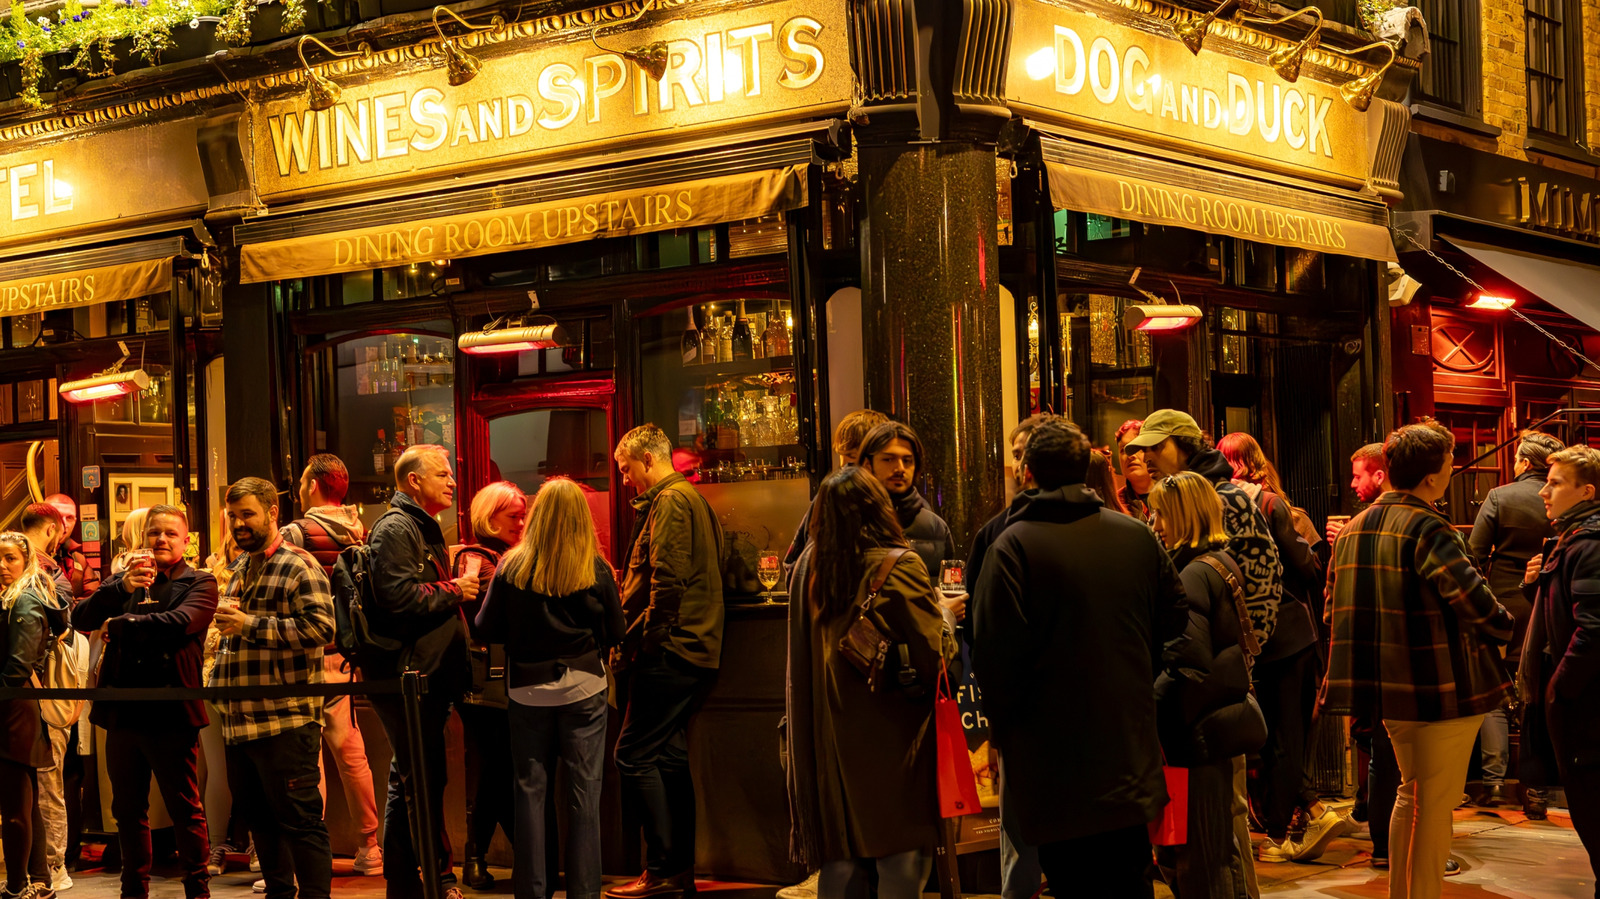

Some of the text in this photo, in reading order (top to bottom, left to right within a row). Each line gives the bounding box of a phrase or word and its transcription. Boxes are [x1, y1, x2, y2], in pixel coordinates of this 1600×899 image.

[268, 15, 826, 178] WINES AND SPIRITS
[1054, 24, 1335, 159] DOG AND DUCK
[334, 190, 693, 268] DINING ROOM UPSTAIRS
[1117, 179, 1347, 249] DINING ROOM UPSTAIRS
